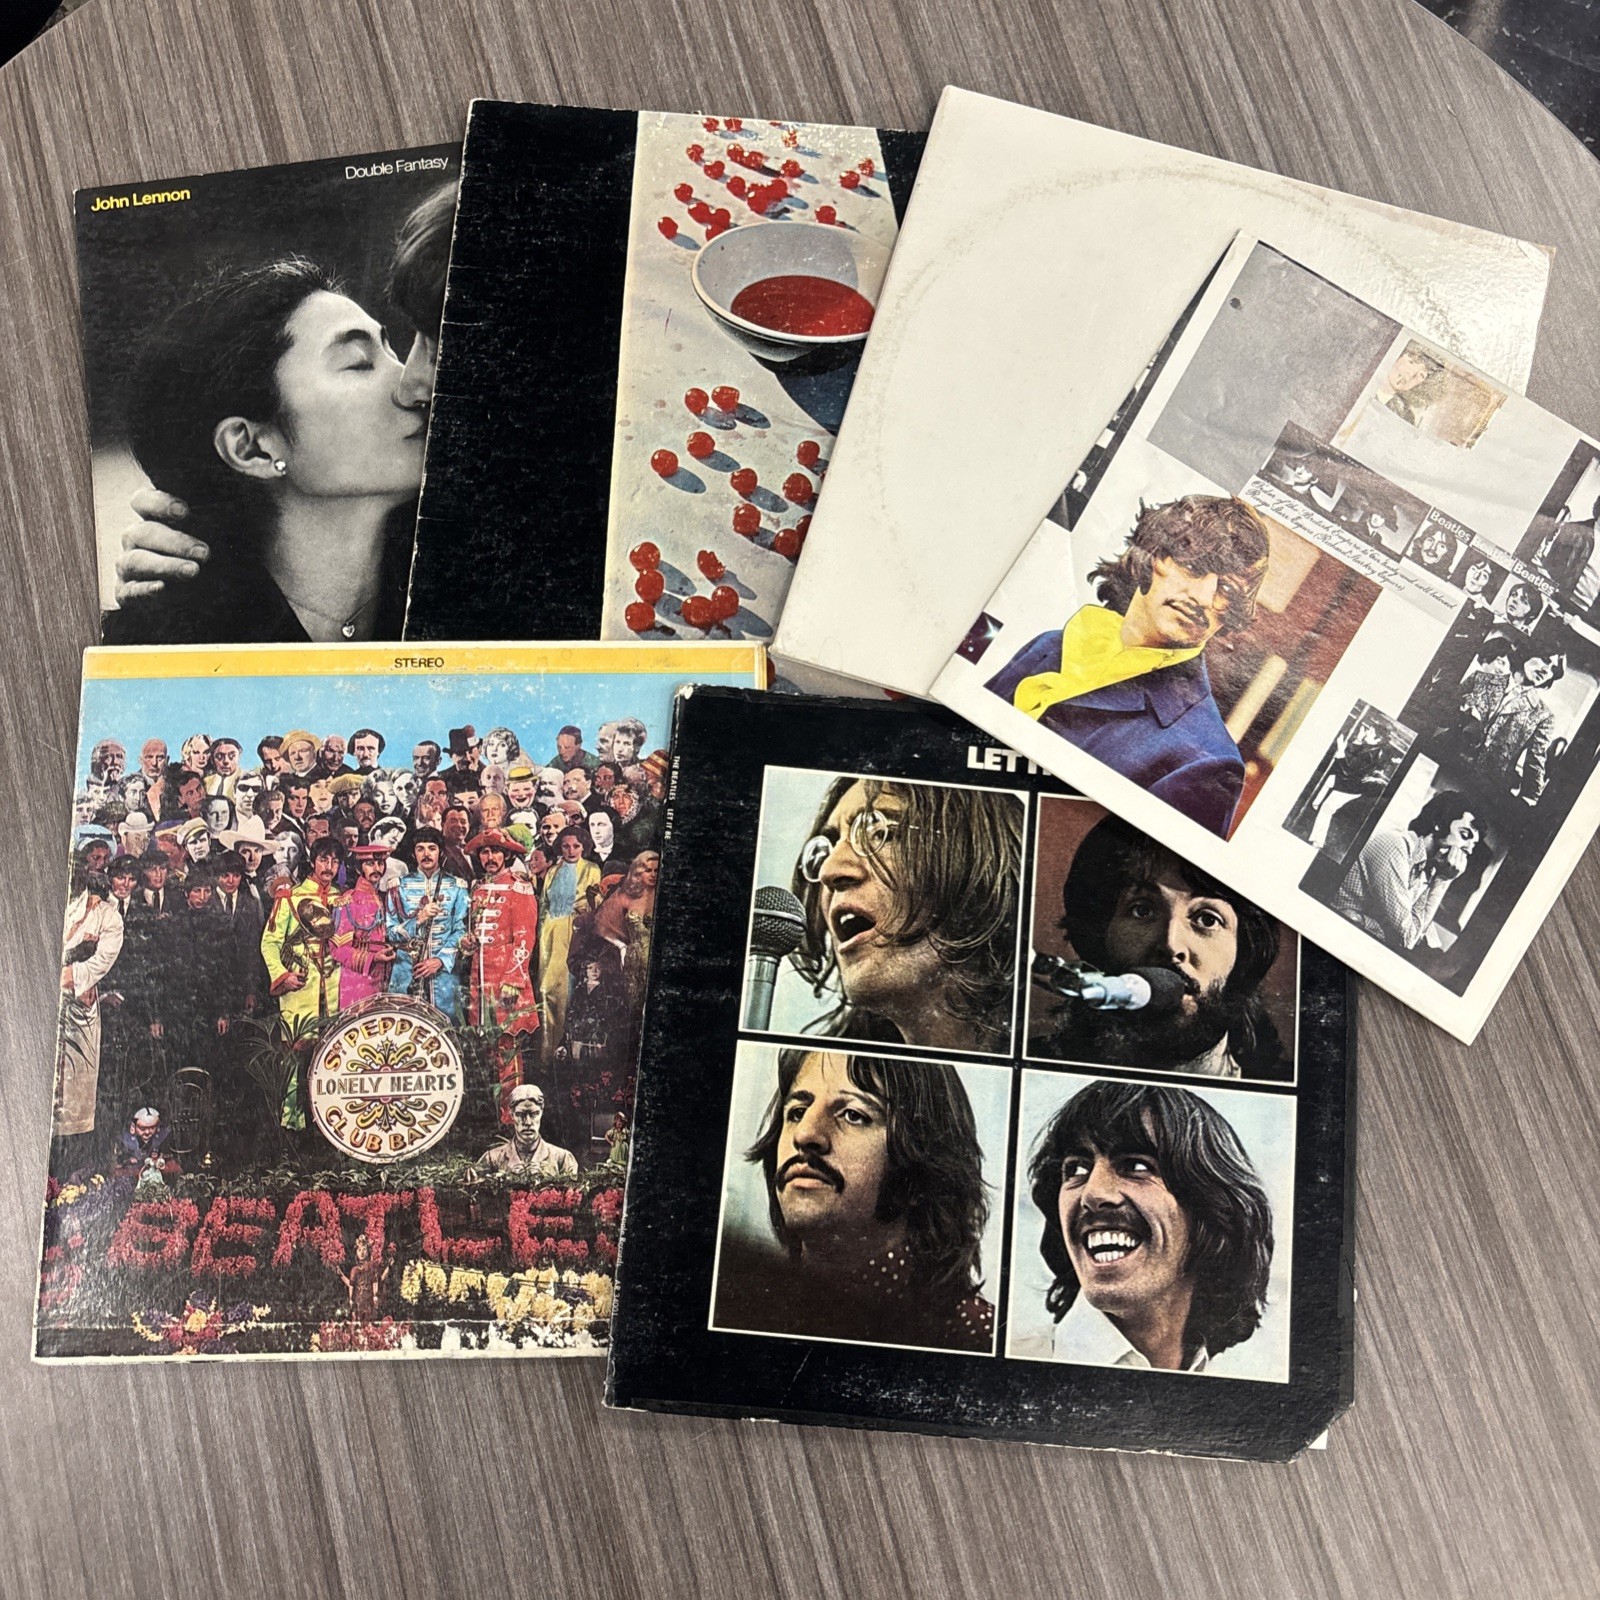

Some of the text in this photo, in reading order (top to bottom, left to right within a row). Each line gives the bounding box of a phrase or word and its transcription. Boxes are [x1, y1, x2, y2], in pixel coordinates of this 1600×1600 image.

[345, 157, 448, 179] Double Fantasy
[90, 189, 191, 212] John Lennon
[1430, 510, 1472, 541] Beatles
[1513, 563, 1555, 595] Beatles
[394, 657, 444, 668] STEREO
[967, 746, 1022, 772] LET
[669, 771, 678, 800] BEATLES
[664, 830, 671, 840] BE
[665, 821, 673, 829] IT
[344, 1017, 450, 1070] PEPPERS
[316, 1073, 457, 1095] LONELY HEARTS
[325, 1100, 448, 1153] CLUB BAND
